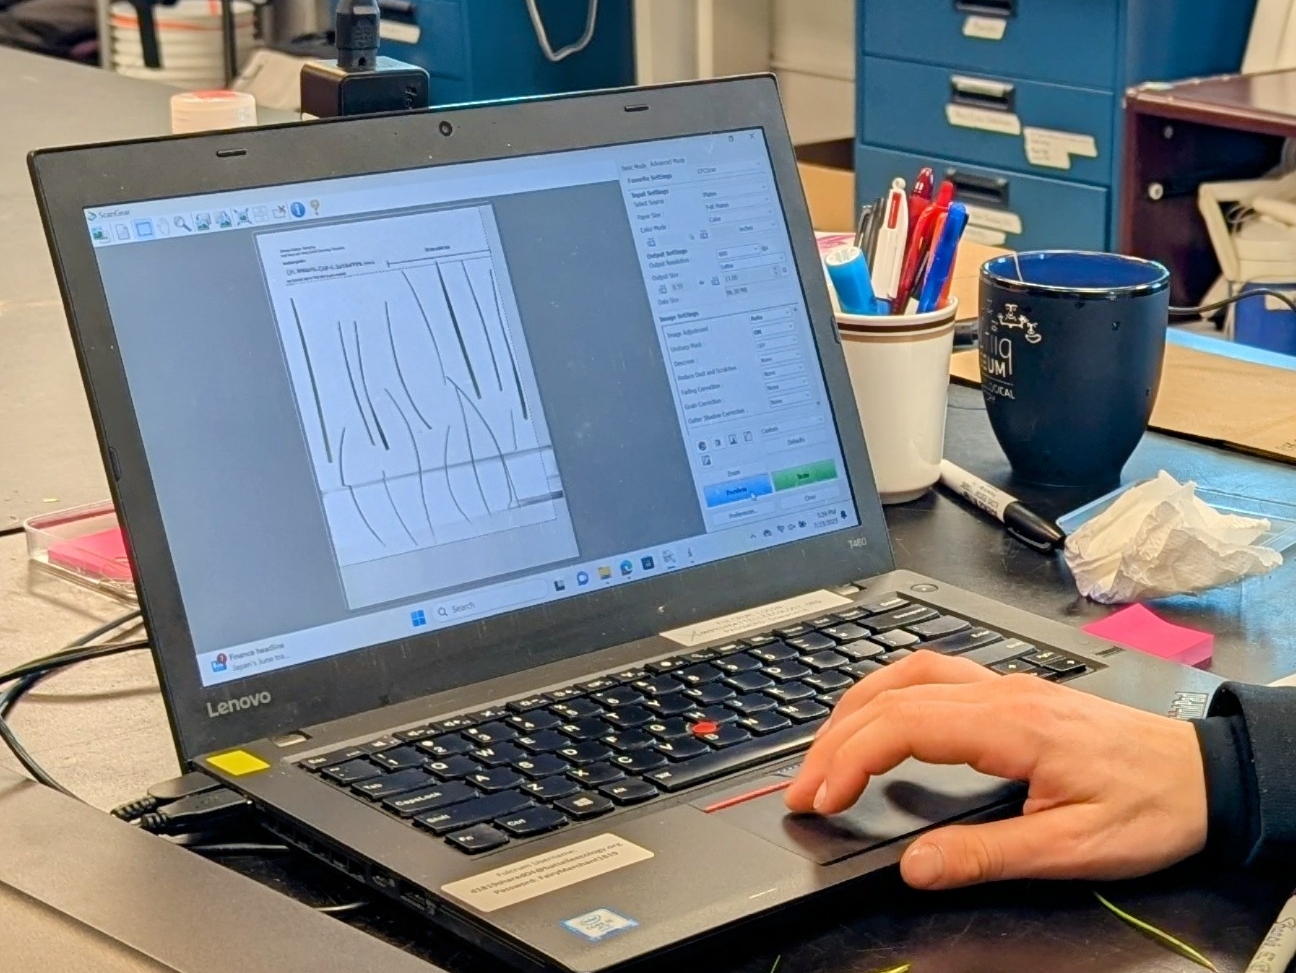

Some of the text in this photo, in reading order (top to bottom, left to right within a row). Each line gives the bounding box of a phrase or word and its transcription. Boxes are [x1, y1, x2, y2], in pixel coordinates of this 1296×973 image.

[650, 158, 673, 167] Advanced
[650, 173, 673, 181] Settings
[631, 188, 669, 199] Input Settings
[98, 208, 131, 220] ScanGear
[646, 248, 688, 260] Output Settings
[659, 311, 699, 322] Image Settings
[666, 331, 682, 339] Image
[451, 600, 476, 614] Search
[229, 641, 285, 662] Finance headline
[206, 690, 272, 718] Lenovo
[363, 782, 383, 791] Tab
[395, 791, 442, 806] CapsLock
[426, 813, 450, 823] Shift
[506, 817, 526, 827] Ctrl
[496, 849, 576, 877] Fulcrum Username:
[493, 877, 538, 895] Password:
